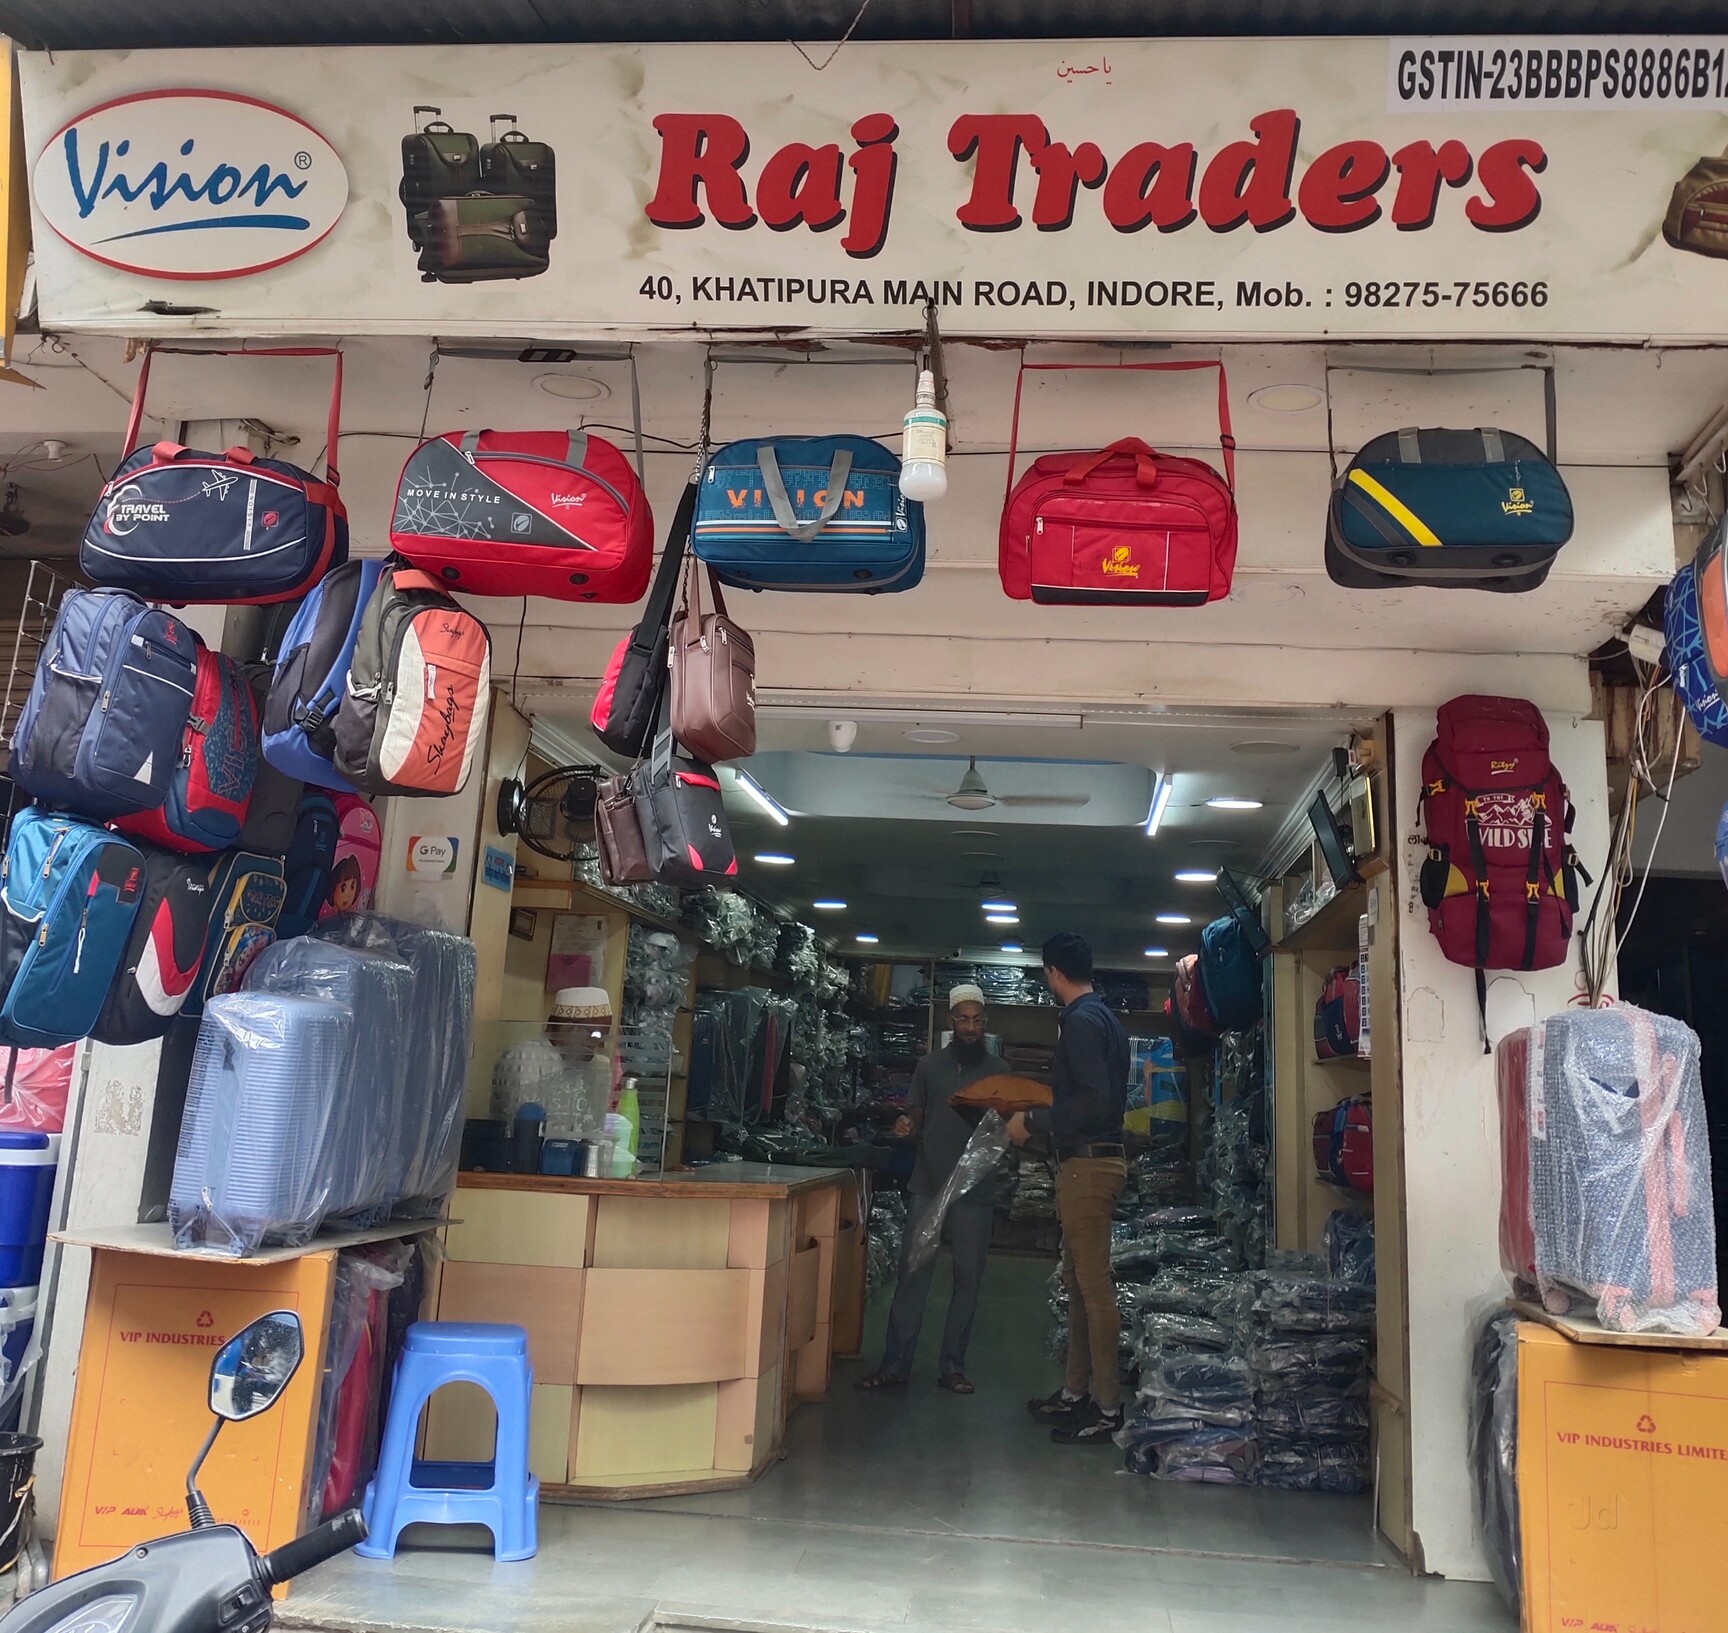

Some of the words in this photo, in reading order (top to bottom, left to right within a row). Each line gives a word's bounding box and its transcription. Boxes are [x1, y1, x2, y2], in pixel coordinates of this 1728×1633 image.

[1399, 48, 1728, 100] GSTIN-23BBBPS8886B1
[64, 127, 309, 219] Vision
[645, 113, 899, 259] Raj
[947, 109, 1549, 233] Traders
[639, 275, 681, 304] 40,
[692, 276, 874, 304] KHATIPURA
[883, 280, 963, 306] MAIN
[974, 281, 1076, 311] ROAD,
[1087, 281, 1224, 311] INDORE,
[1236, 281, 1312, 307] Mob.
[1344, 281, 1549, 308] 98275-75666
[406, 488, 440, 499] MOVE
[444, 491, 457, 499] IN
[460, 493, 501, 504] STYLE
[726, 489, 865, 510] VIION
[121, 504, 166, 514] TRAVEL
[115, 513, 130, 522] BY
[133, 513, 170, 522] POINT
[430, 845, 447, 857] Pay
[120, 1331, 142, 1343] VIP
[145, 1332, 226, 1347] INDUSTRIES
[1556, 1431, 1581, 1445] VIP
[1585, 1434, 1673, 1455] INDUSTRIES
[95, 1505, 117, 1516] VIP
[1561, 1617, 1584, 1628] VIP
